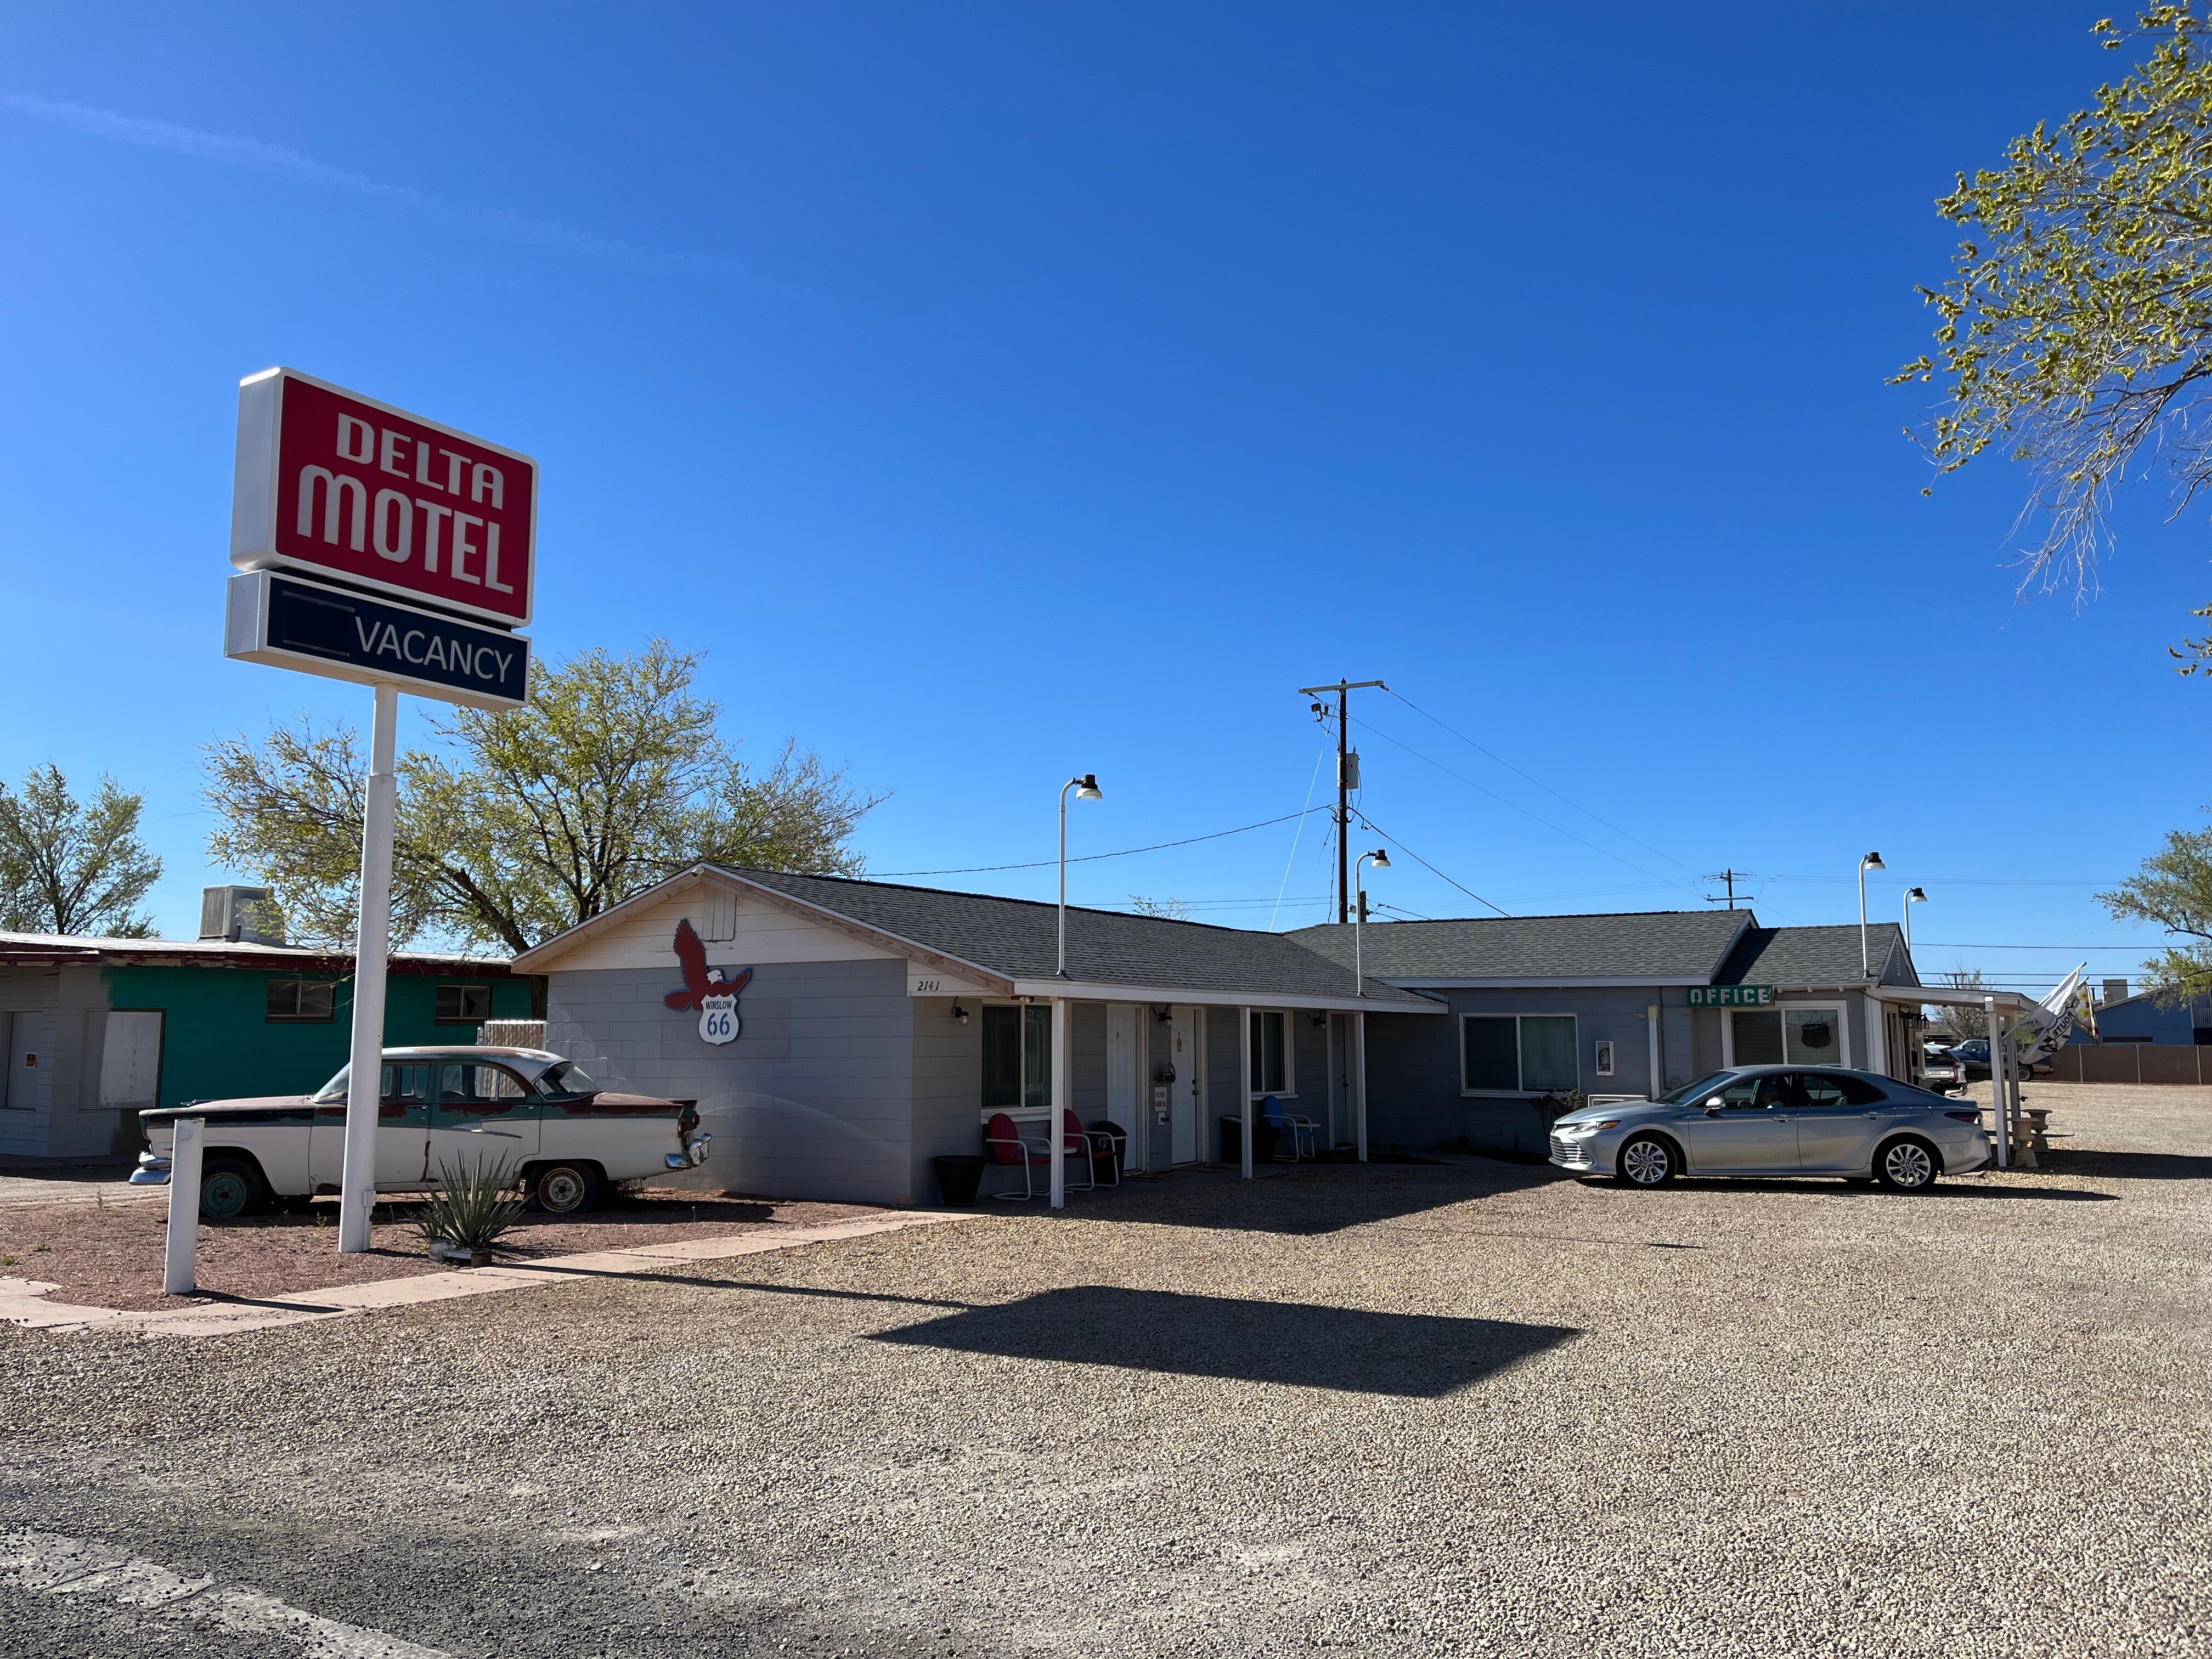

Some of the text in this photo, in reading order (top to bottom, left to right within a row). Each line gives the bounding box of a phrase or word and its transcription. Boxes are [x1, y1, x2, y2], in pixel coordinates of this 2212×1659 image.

[336, 412, 504, 510] DELTA
[297, 464, 514, 594] MOTEL
[355, 616, 513, 683] VACANCY
[917, 980, 940, 991] 2141
[1690, 989, 1770, 1004] OFFICE
[705, 1000, 732, 1010] WINSLOW
[707, 1012, 730, 1036] 66
